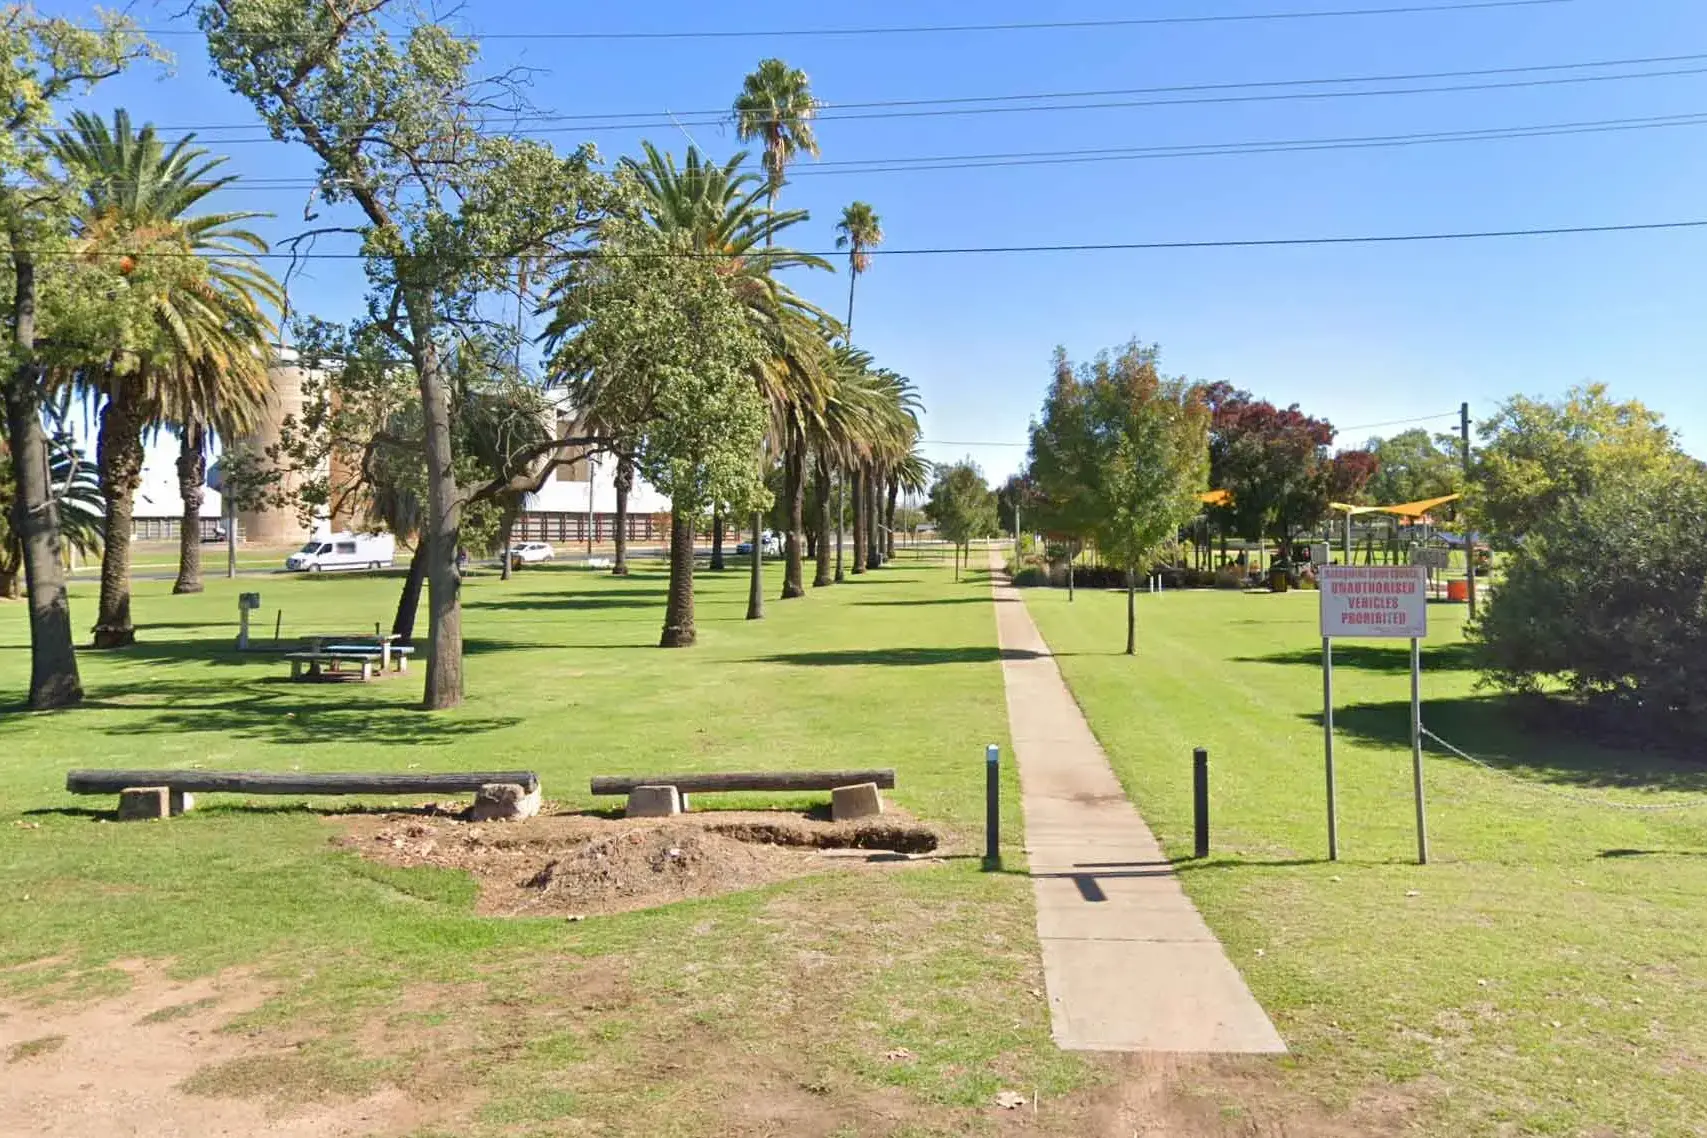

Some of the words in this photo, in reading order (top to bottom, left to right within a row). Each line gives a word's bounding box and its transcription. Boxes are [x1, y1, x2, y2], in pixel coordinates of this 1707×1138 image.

[1331, 582, 1415, 594] UNAUTHORISED
[1348, 596, 1399, 609] VEHICLES
[1341, 612, 1406, 625] PROHIBITED
